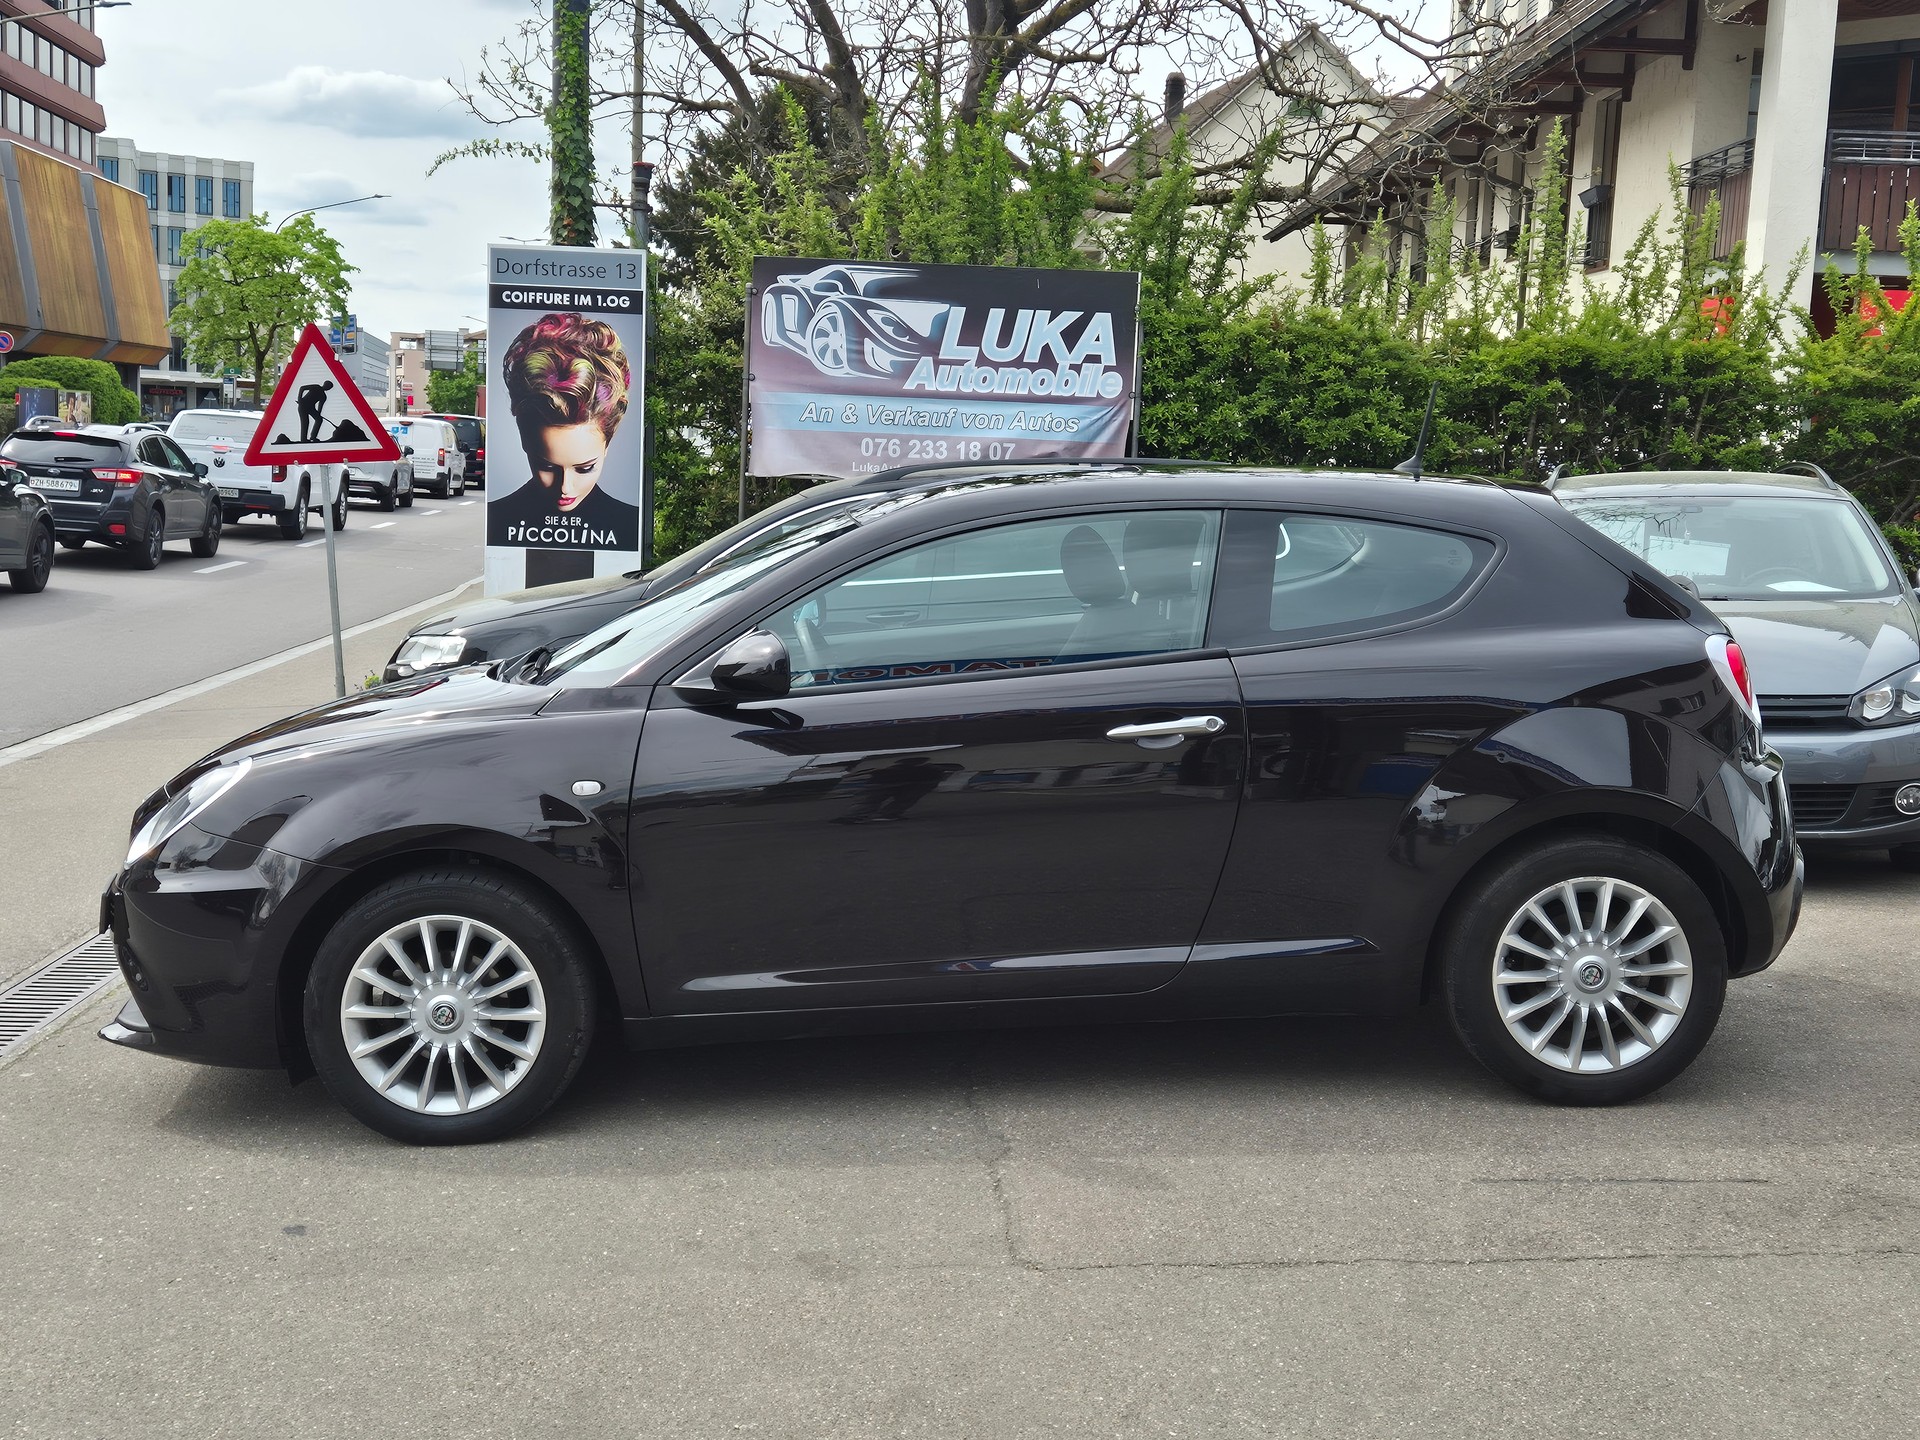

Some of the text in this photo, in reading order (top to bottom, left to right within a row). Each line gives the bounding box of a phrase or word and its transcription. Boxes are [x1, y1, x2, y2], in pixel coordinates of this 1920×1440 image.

[496, 257, 637, 280] Dorfstrasse 13
[501, 290, 631, 308] COIFFURE IM 1.OG
[938, 305, 1117, 367] LUKA
[902, 356, 1124, 400] Automobile
[799, 401, 1082, 434] An & Verkauf von Autos
[860, 436, 1016, 462] 076 233 18 07
[544, 515, 582, 527] SIE & ER
